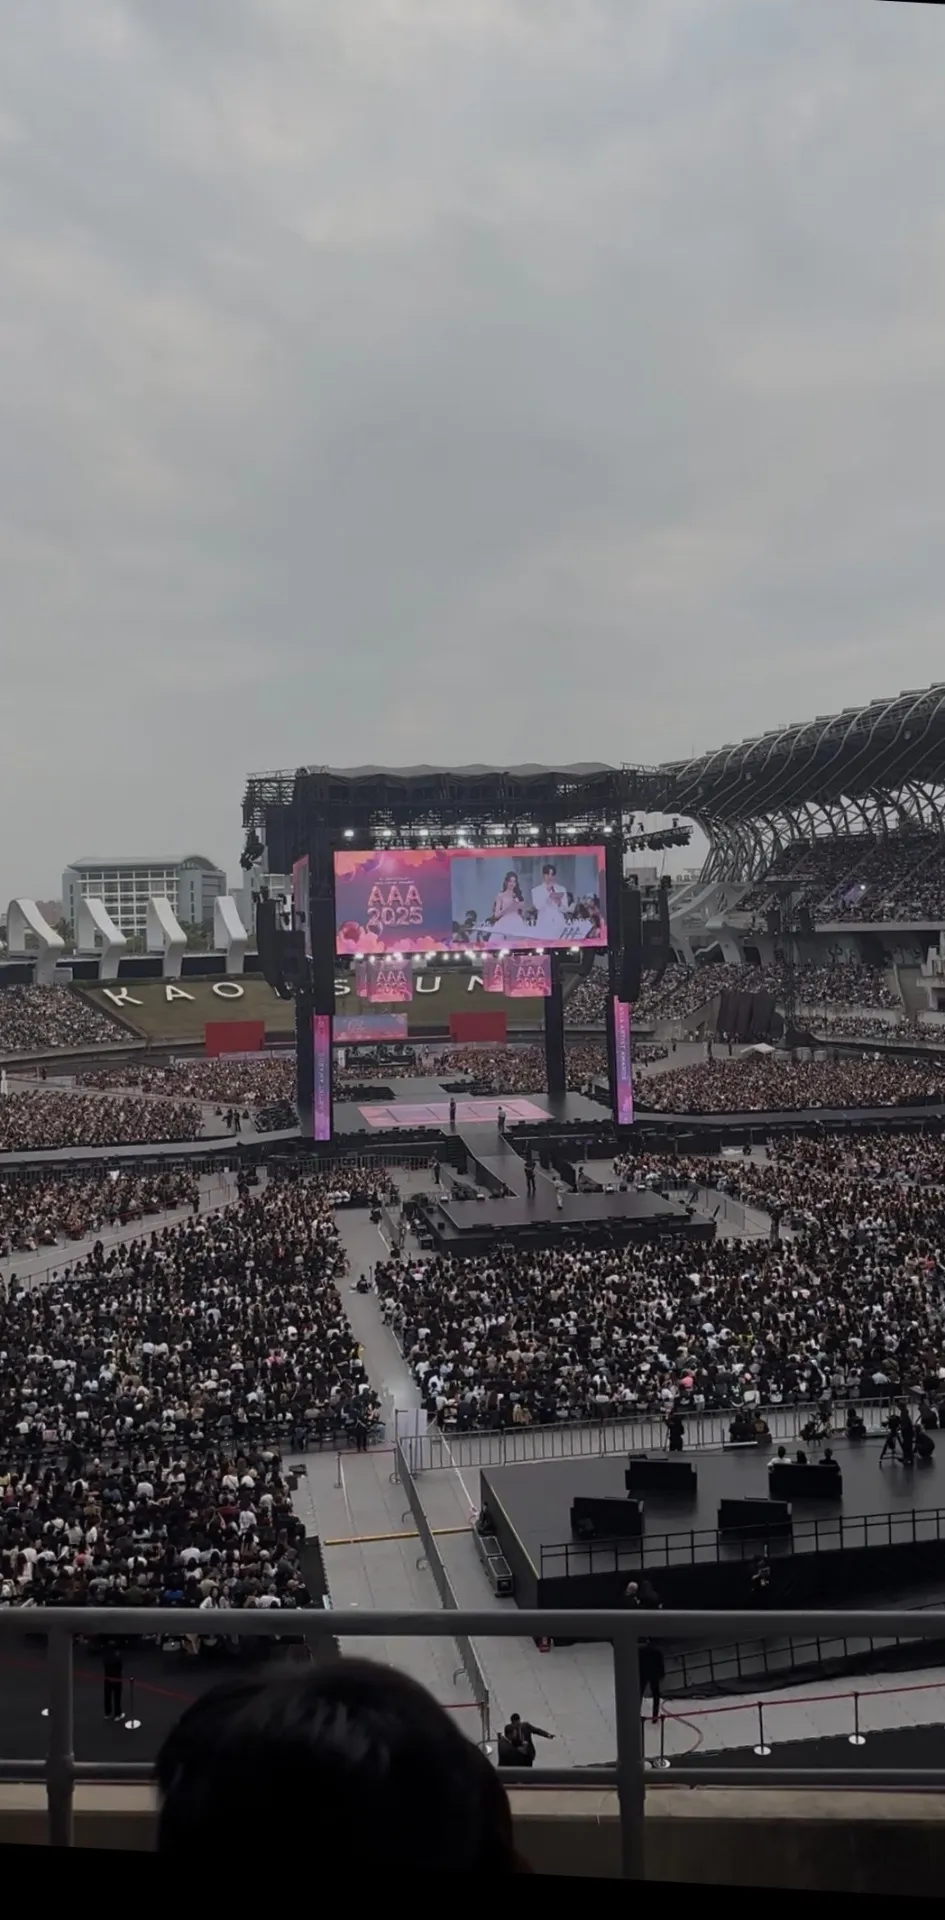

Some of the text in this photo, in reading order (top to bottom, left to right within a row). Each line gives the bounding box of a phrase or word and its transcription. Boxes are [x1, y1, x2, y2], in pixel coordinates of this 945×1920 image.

[368, 885, 422, 906] AAA
[367, 906, 423, 925] 2025
[376, 970, 407, 983] AAA
[516, 966, 545, 979] AAA
